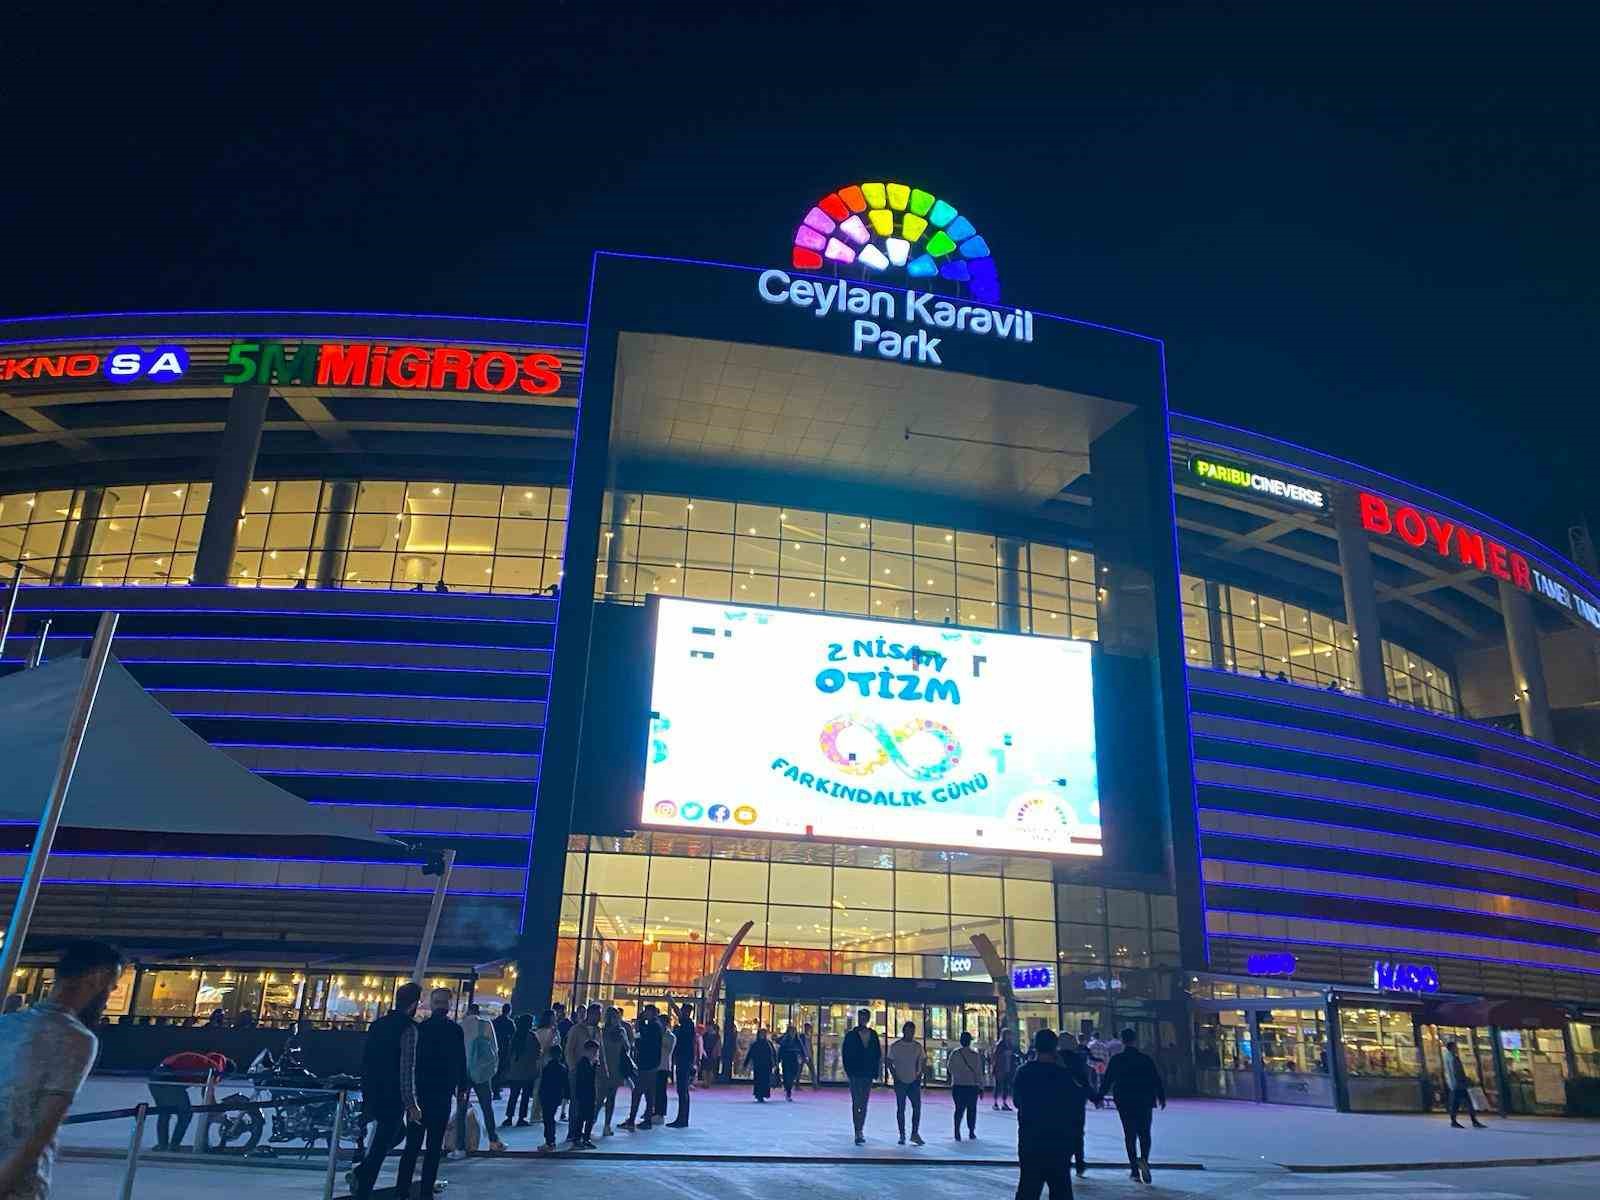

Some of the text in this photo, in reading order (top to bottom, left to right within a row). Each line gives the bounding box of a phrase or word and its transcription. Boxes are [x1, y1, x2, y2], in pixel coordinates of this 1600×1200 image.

[758, 269, 1033, 342] Ceylan Karavil
[853, 320, 942, 365] Park
[828, 643, 848, 662] 2
[815, 666, 961, 704] OTİZM
[771, 757, 989, 806] FARKINDALIK GÜNÜ
